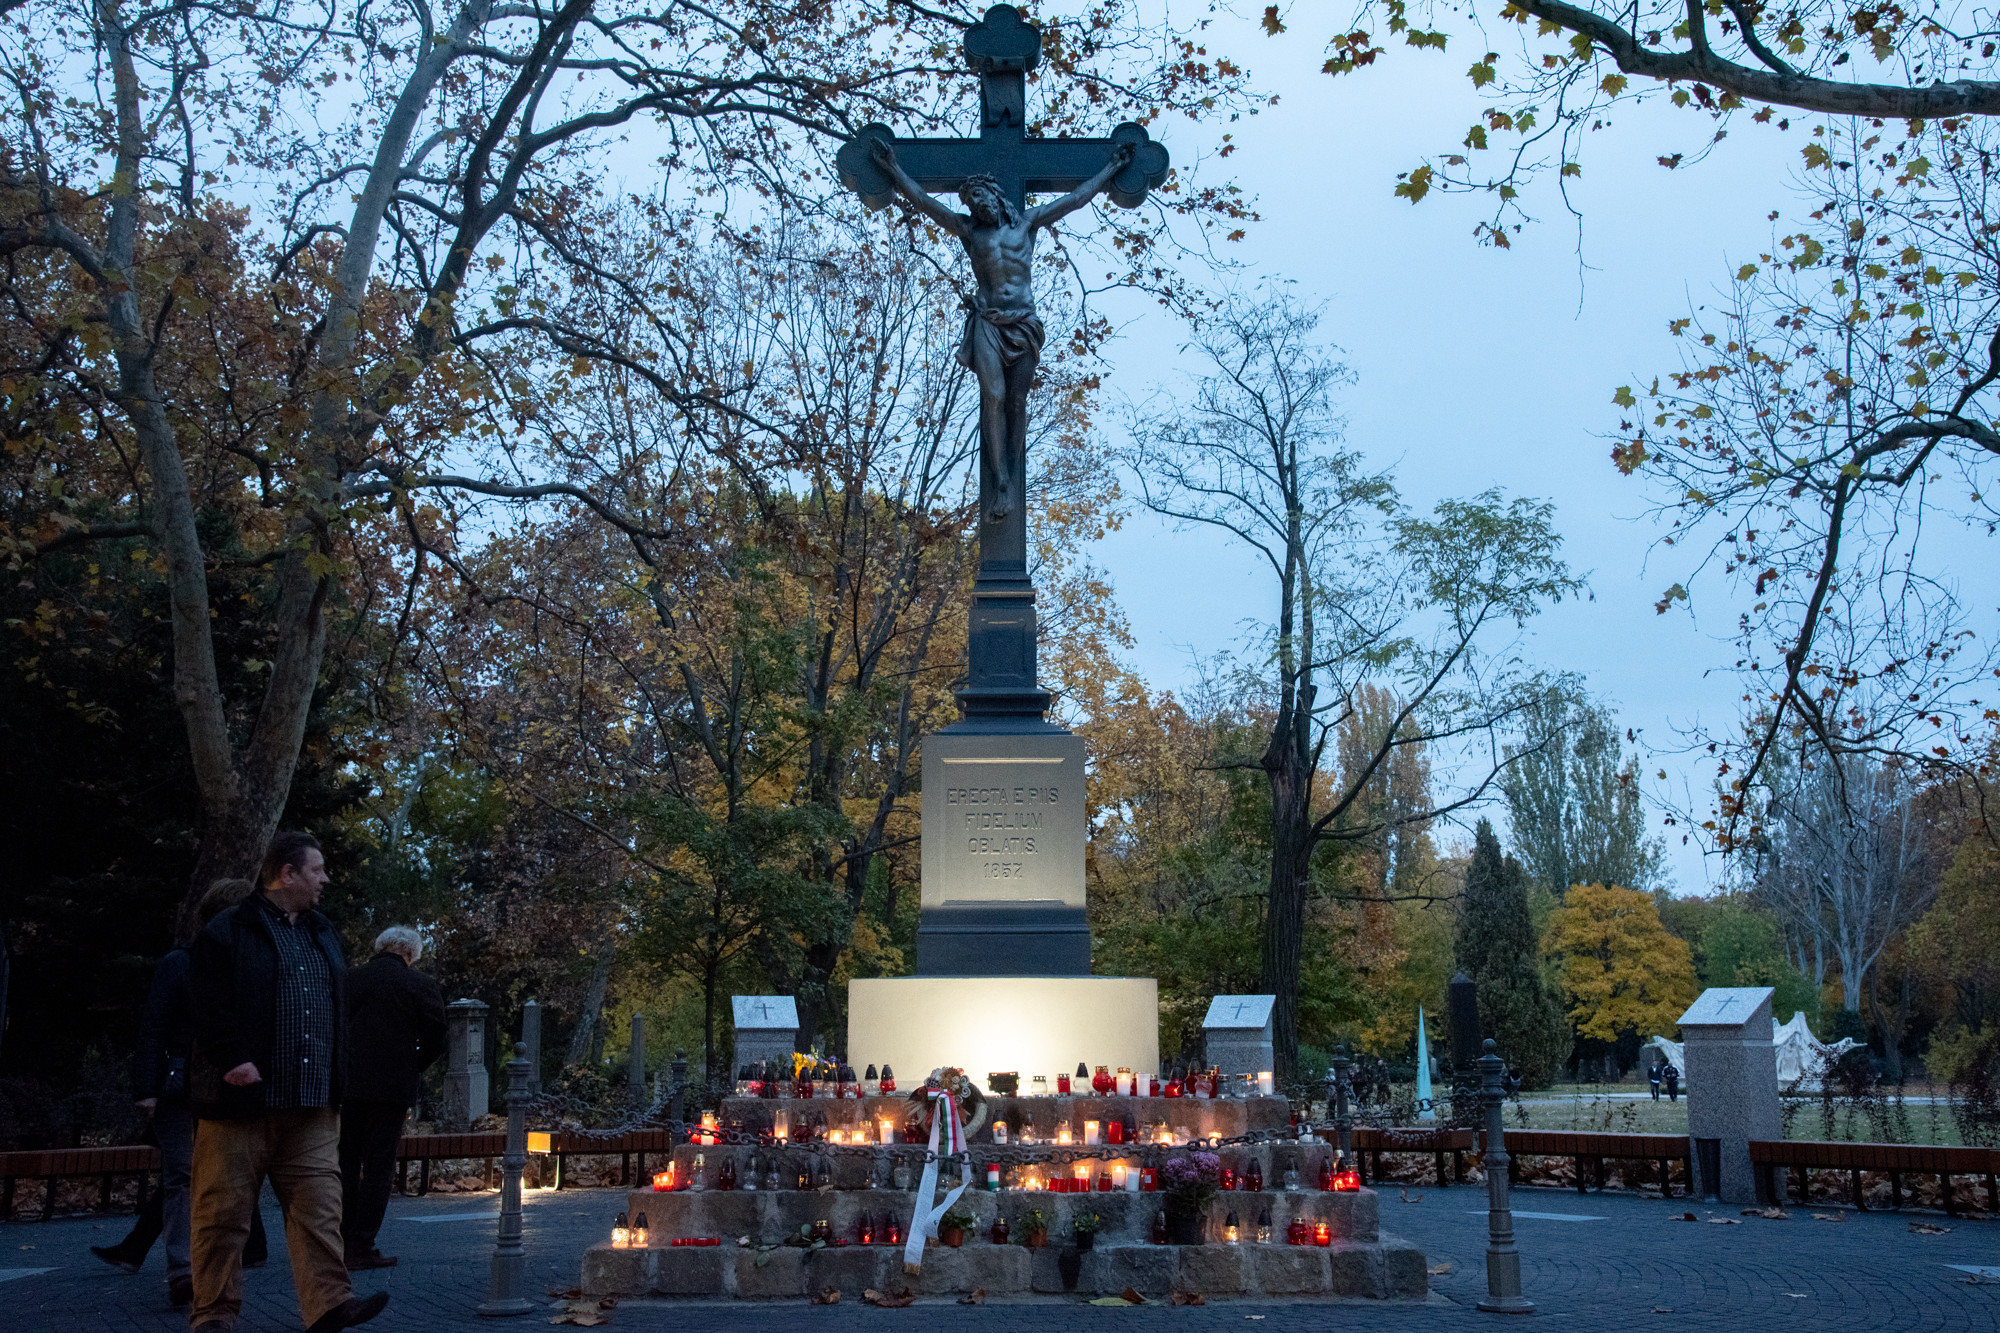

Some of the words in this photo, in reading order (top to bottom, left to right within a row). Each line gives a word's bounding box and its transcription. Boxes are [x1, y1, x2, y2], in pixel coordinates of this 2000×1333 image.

[947, 788, 1008, 806] ERECTA
[1014, 788, 1023, 805] E
[1028, 788, 1059, 805] PIIS
[965, 813, 1042, 831] FIDELIUM
